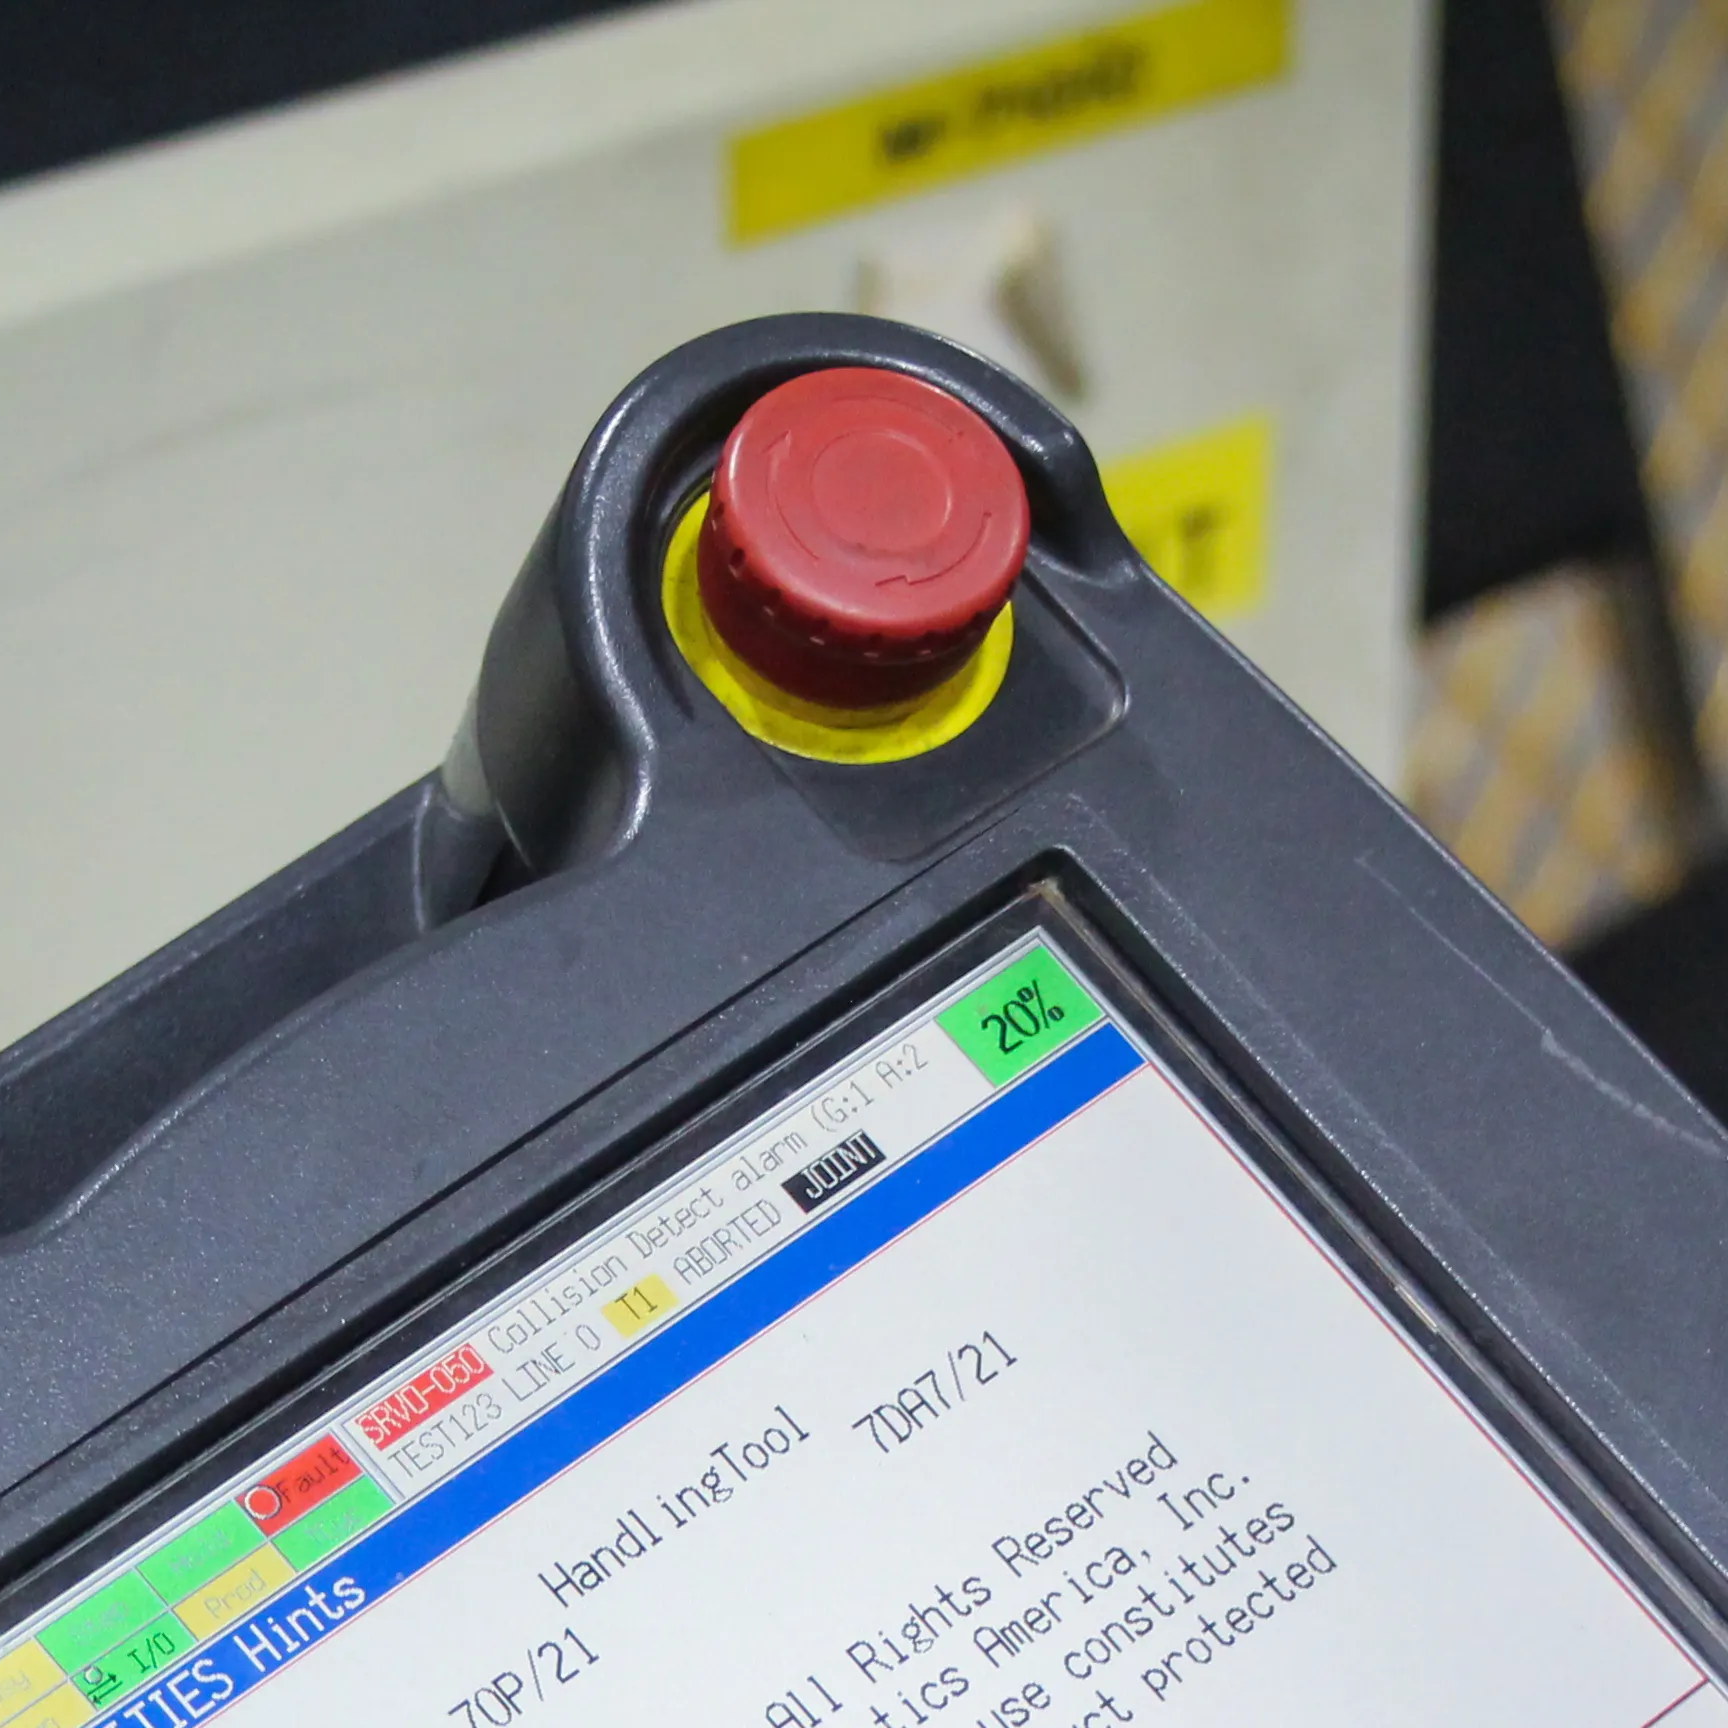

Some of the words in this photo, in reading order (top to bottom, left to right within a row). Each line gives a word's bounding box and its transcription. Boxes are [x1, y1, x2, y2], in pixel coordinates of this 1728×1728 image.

[981, 979, 1064, 1054] 20%
[358, 1347, 484, 1445] SRVO-050
[487, 1253, 626, 1354] Collision
[626, 1187, 723, 1259] Detect
[734, 1131, 808, 1191] alarm
[811, 1080, 875, 1132] (G:1
[388, 1393, 502, 1478] TEST123
[502, 1342, 575, 1401] LINE
[615, 1287, 658, 1320] T1
[674, 1200, 781, 1285] ABORTED
[805, 1133, 879, 1200] JOINT
[277, 1447, 349, 1505] Fault
[539, 1405, 809, 1607] HandlingTool
[852, 1330, 1017, 1453] 7DA7/21
[204, 1571, 266, 1618] Prod
[234, 1577, 365, 1673] Hints
[846, 1577, 991, 1683] Rights
[992, 1430, 1177, 1577] Reserved
[973, 1548, 1152, 1668] America,
[1157, 1473, 1250, 1530] Inc.
[1064, 1502, 1295, 1679] constitutes
[1141, 1535, 1337, 1700] protected
[128, 1631, 175, 1673] I/O
